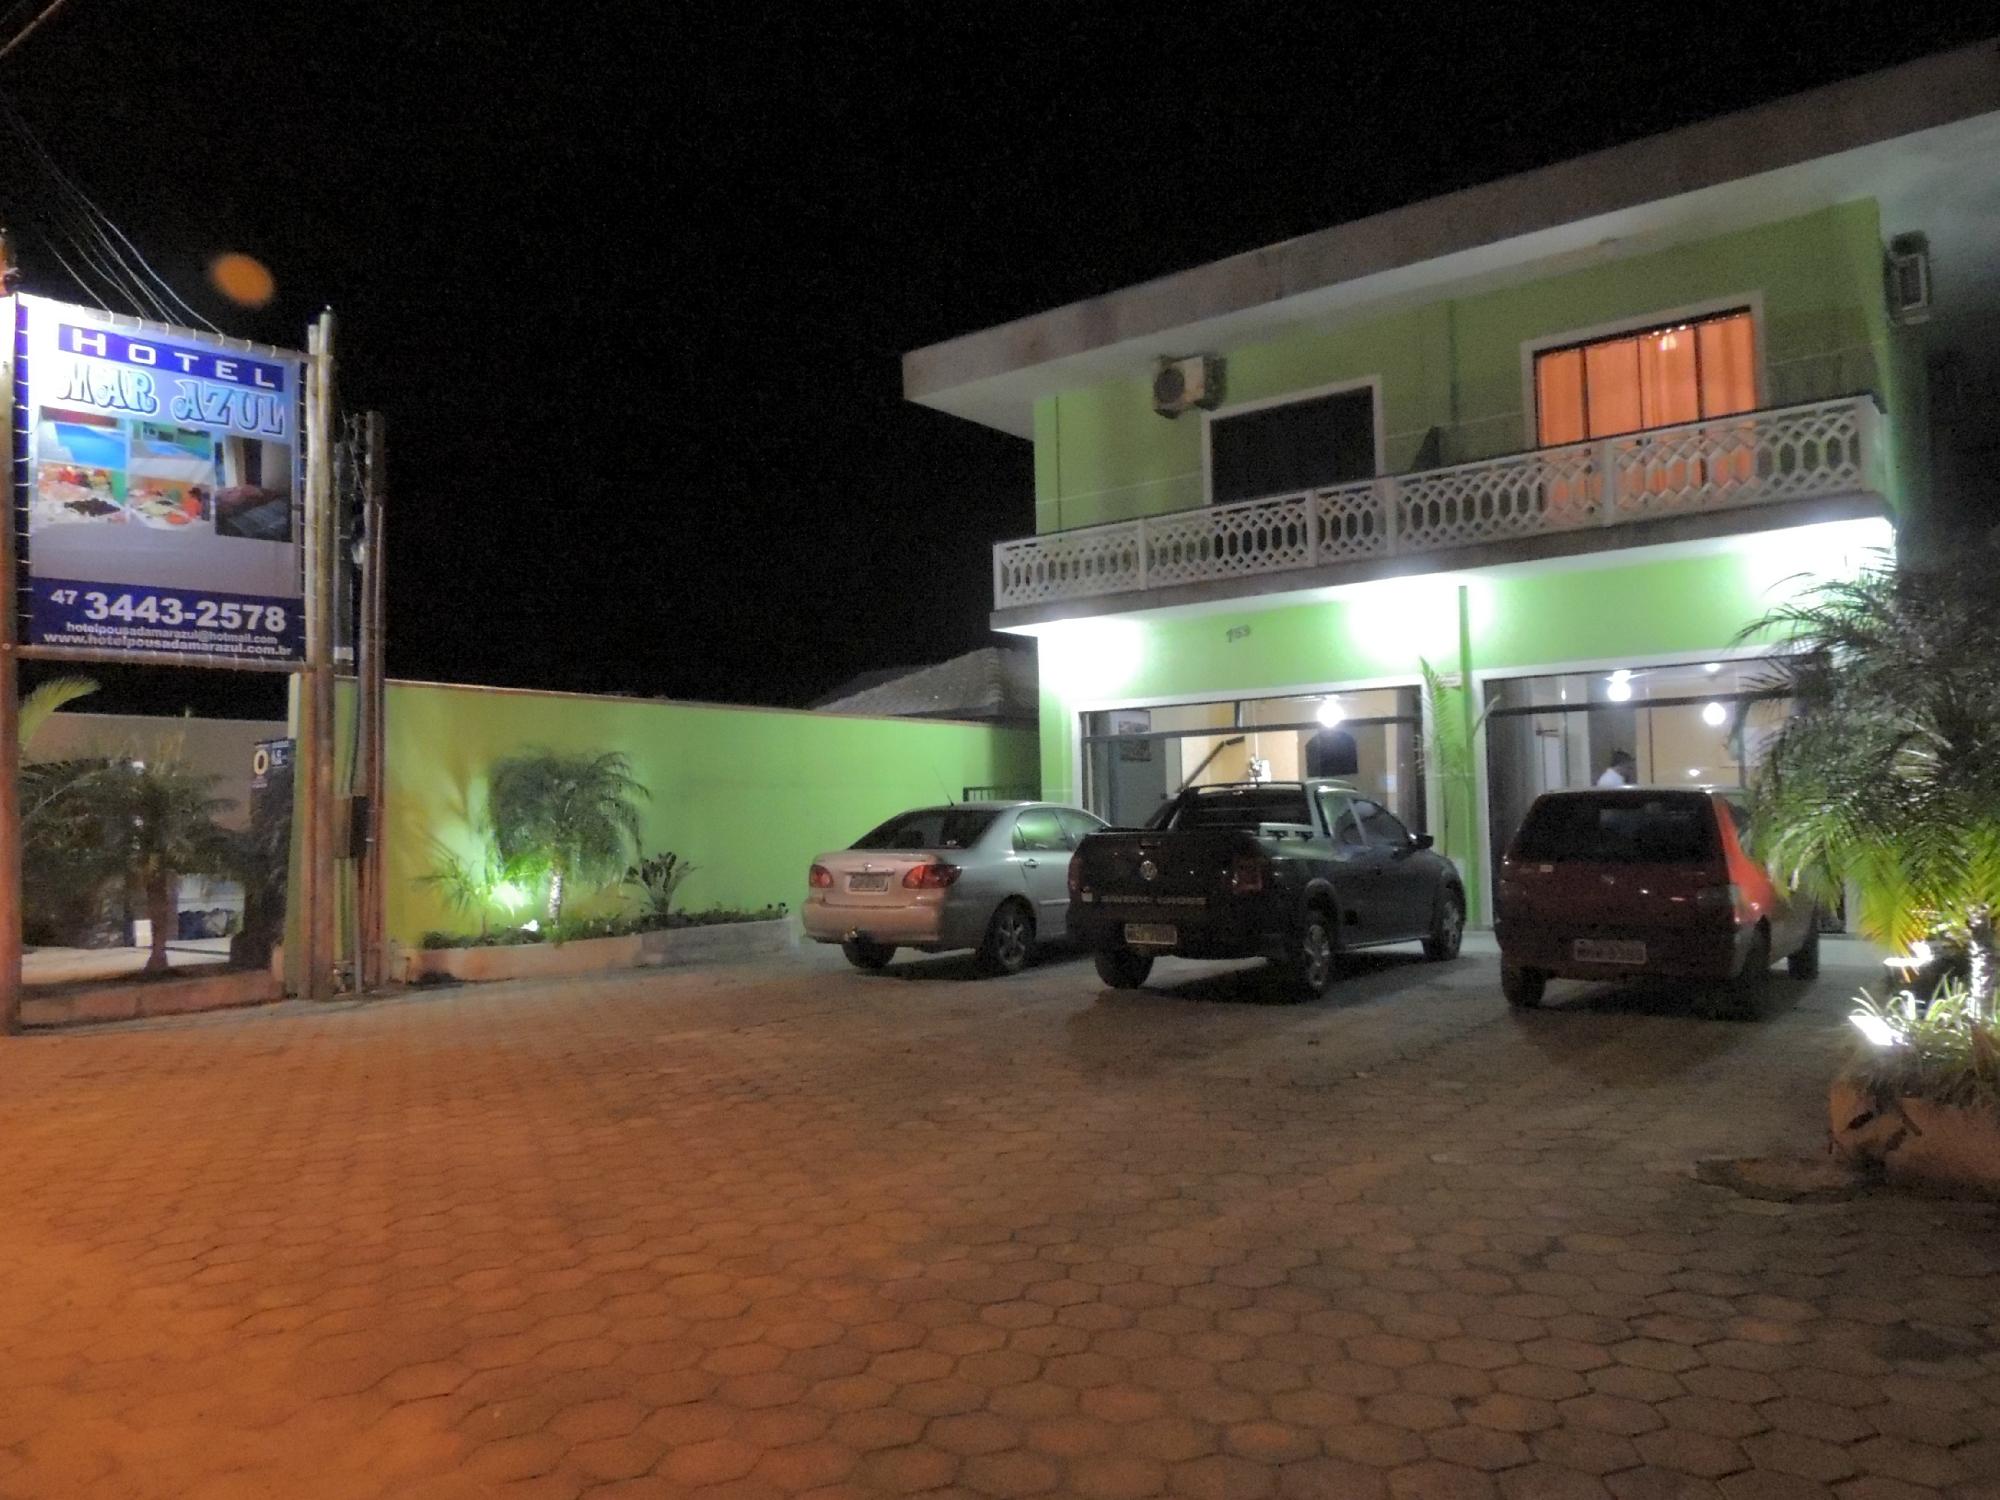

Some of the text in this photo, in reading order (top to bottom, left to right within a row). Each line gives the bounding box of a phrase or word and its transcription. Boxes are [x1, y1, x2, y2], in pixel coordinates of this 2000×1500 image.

[72, 328, 275, 388] HOTEL
[57, 362, 288, 438] MAR AZUL
[50, 589, 287, 632] 47 3443-2578
[44, 632, 292, 656] www.hotelpousadamarazul.com.br
[66, 621, 278, 645] hotelpousadamarazul@hotmail.com
